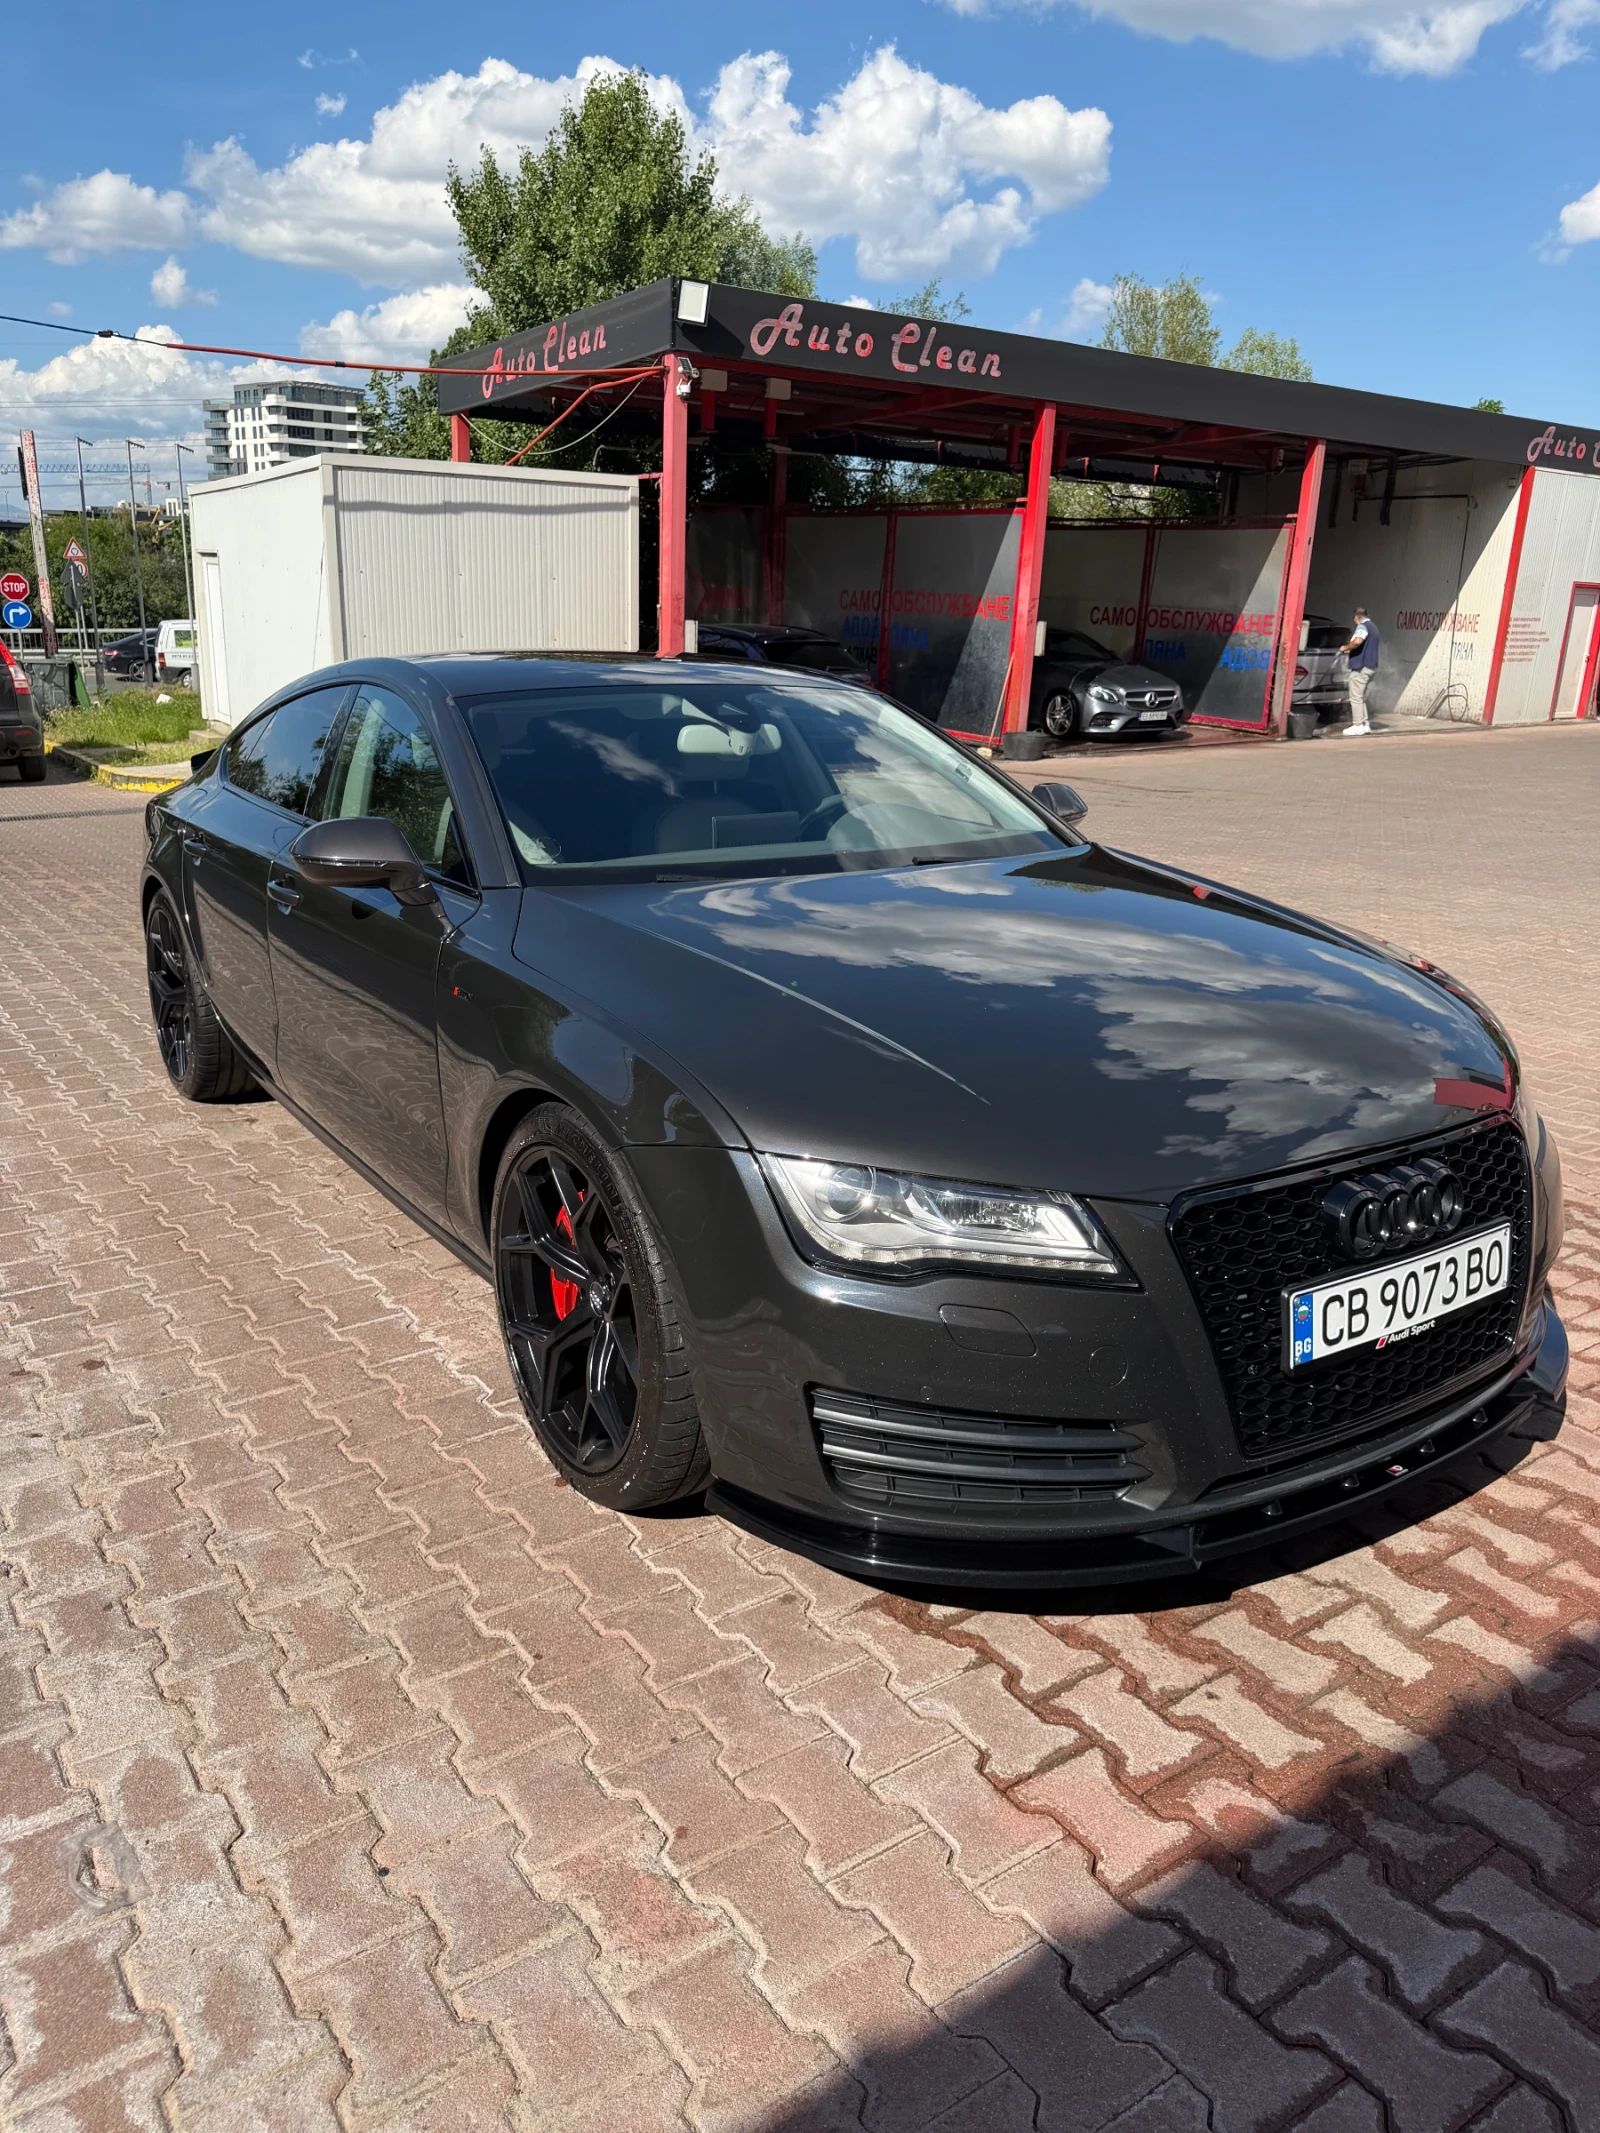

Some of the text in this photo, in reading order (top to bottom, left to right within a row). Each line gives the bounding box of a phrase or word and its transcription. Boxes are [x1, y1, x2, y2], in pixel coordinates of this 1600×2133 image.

[750, 303, 1002, 378] Auto Clean
[482, 321, 607, 399] Auto Clean
[1526, 425, 1587, 462] Auto
[3, 582, 26, 593] STOP
[1321, 1239, 1503, 1346] CB 9073 BO
[1295, 1337, 1312, 1357] BG
[1388, 1319, 1435, 1344] Audi Sport
